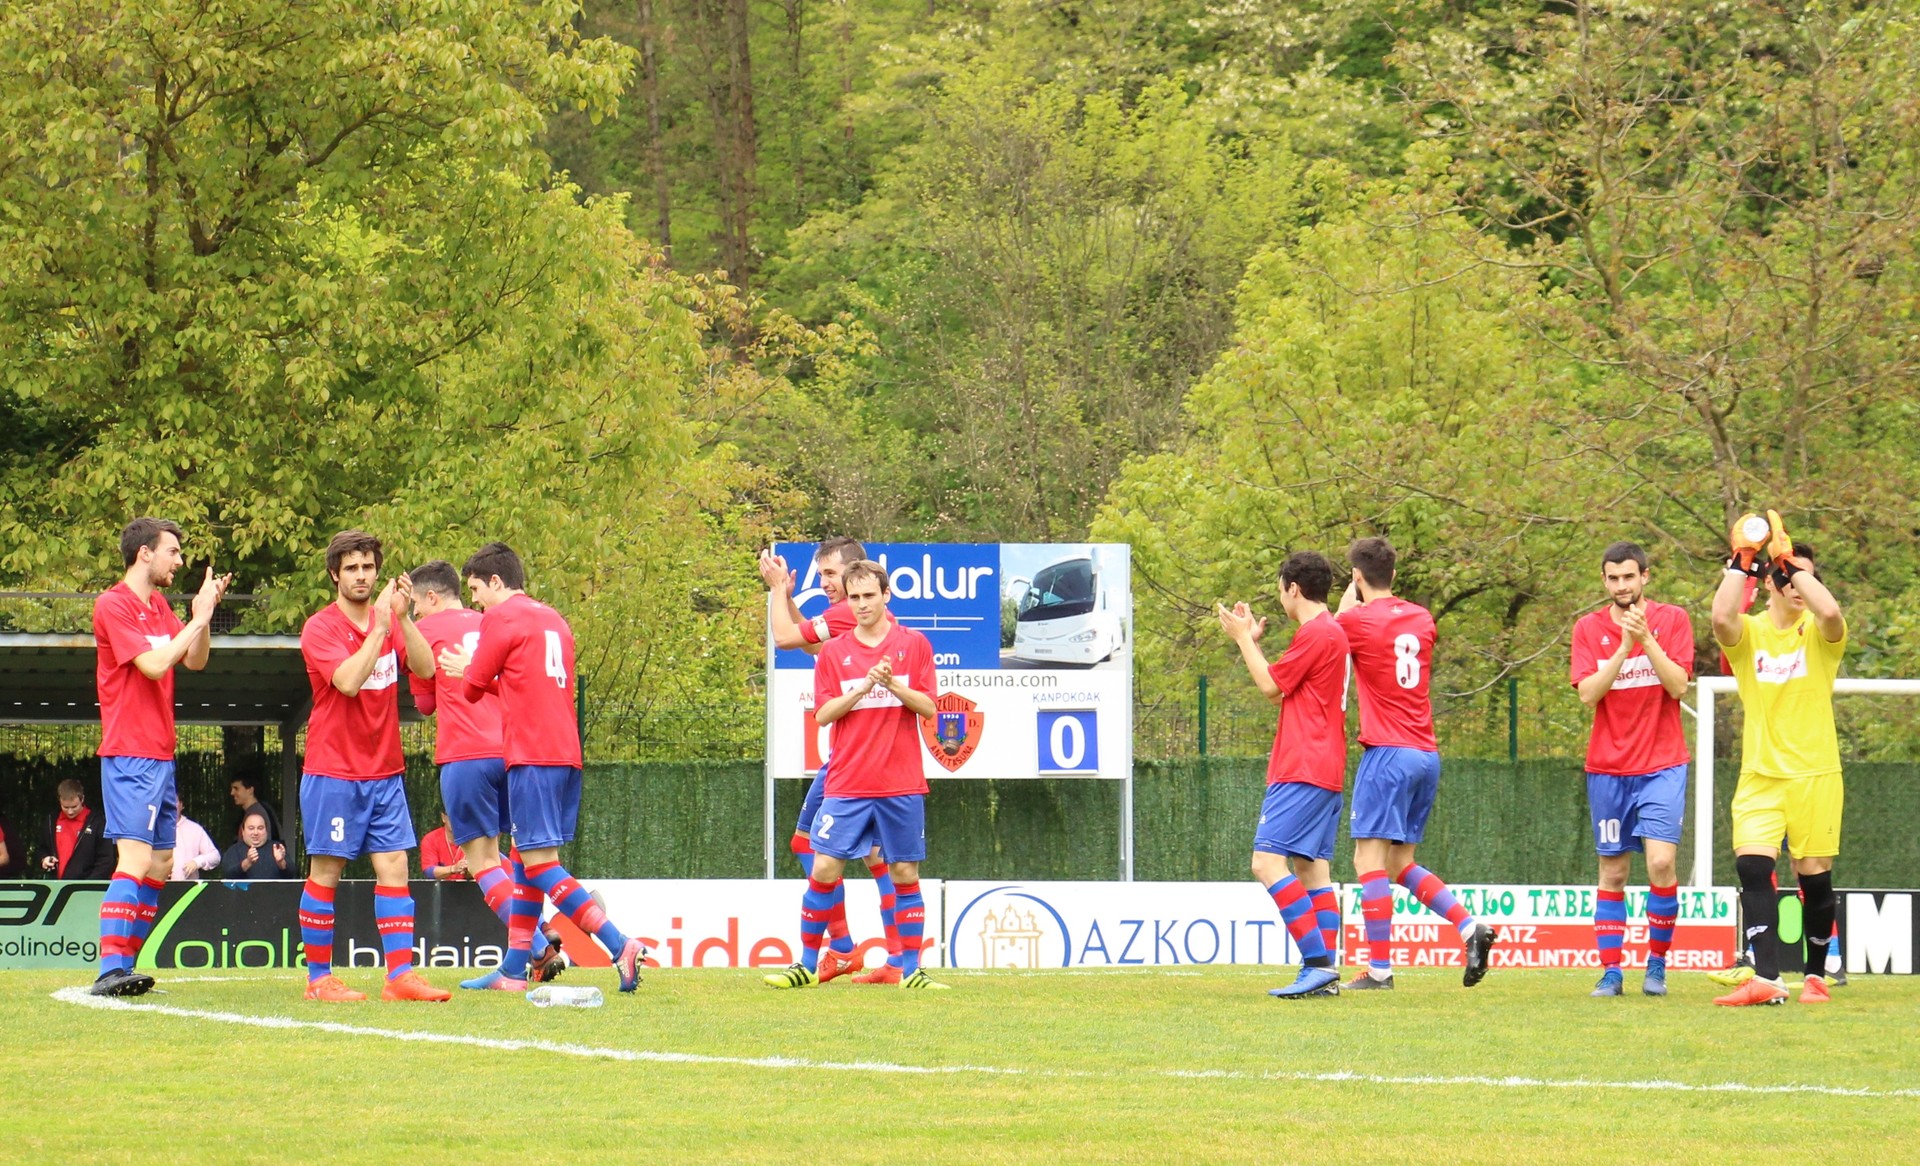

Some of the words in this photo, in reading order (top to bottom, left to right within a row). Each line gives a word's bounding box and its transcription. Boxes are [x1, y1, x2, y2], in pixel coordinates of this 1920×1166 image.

[544, 630, 567, 688] 4
[933, 653, 960, 666] om
[1394, 633, 1420, 689] 8
[940, 671, 1057, 688] aitasuna.com
[936, 695, 969, 712] ZKOITIA
[1032, 691, 1101, 703] KANPOKOAK
[1050, 715, 1086, 769] 0
[930, 745, 974, 767] ANAITASUNA
[147, 804, 157, 830] 7
[330, 816, 345, 842] 3
[817, 814, 835, 839] 2
[1598, 818, 1621, 843] 10
[632, 916, 935, 968] sideor
[1078, 918, 1303, 965] AZKOITI
[1494, 926, 1537, 943] ATZ
[1846, 892, 1913, 974] M
[0, 935, 101, 962] olindeg
[349, 936, 503, 968] bdaia
[1413, 948, 1461, 966] AITZ
